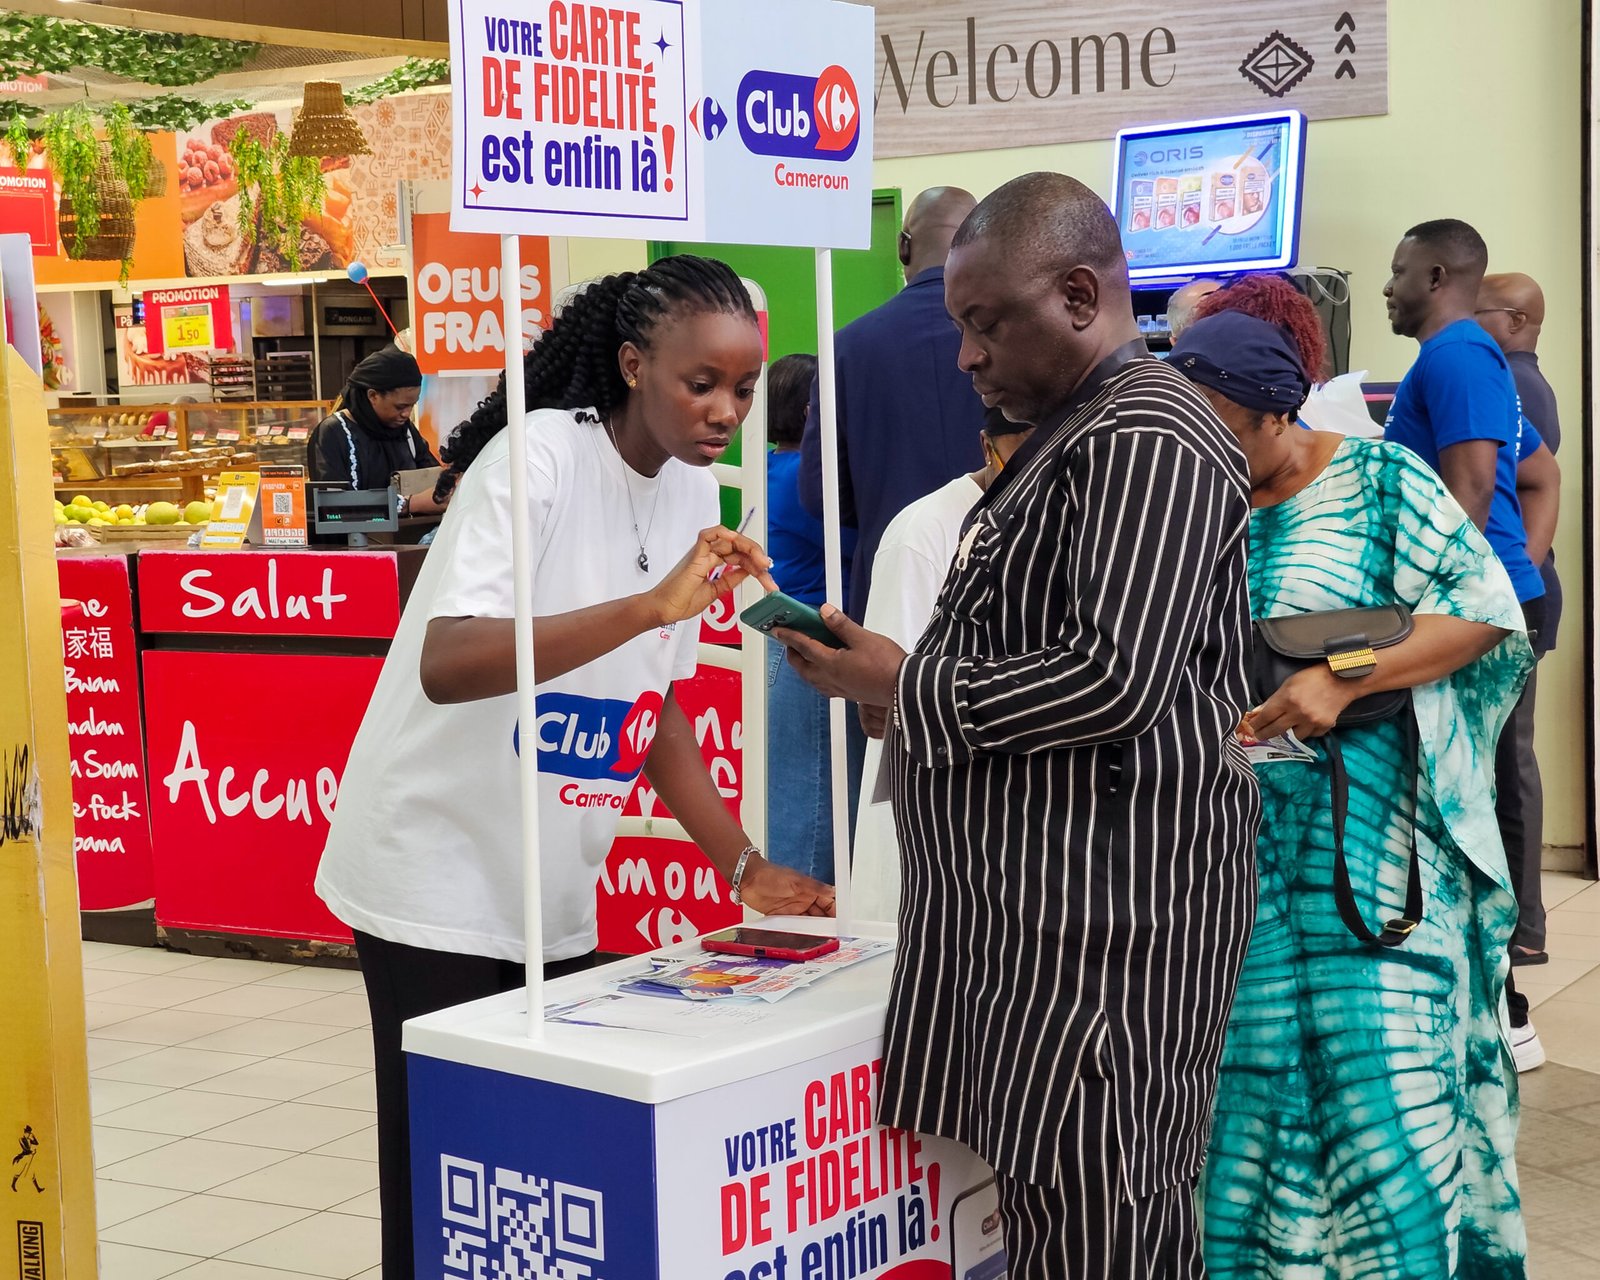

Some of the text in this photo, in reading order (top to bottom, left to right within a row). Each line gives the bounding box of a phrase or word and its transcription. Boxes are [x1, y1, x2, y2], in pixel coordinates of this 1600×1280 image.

[484, 0, 642, 70] VOTRE CARTE
[482, 56, 658, 133] DE FIDELITÉ
[745, 89, 811, 138] Club
[481, 130, 534, 185] est
[544, 134, 621, 190] enfin
[774, 163, 850, 191] Cameroun
[1150, 146, 1203, 163] ORIS
[152, 287, 219, 304] PROMOTION
[417, 262, 542, 305] OEUS
[423, 308, 544, 355] FRAS
[179, 558, 348, 622] Salut
[63, 626, 115, 660] 家福
[535, 711, 611, 760] Club
[163, 719, 340, 826] Accue
[724, 1117, 798, 1178] VOTRE
[720, 1172, 773, 1257] DE
[801, 1209, 888, 1280] enfin
